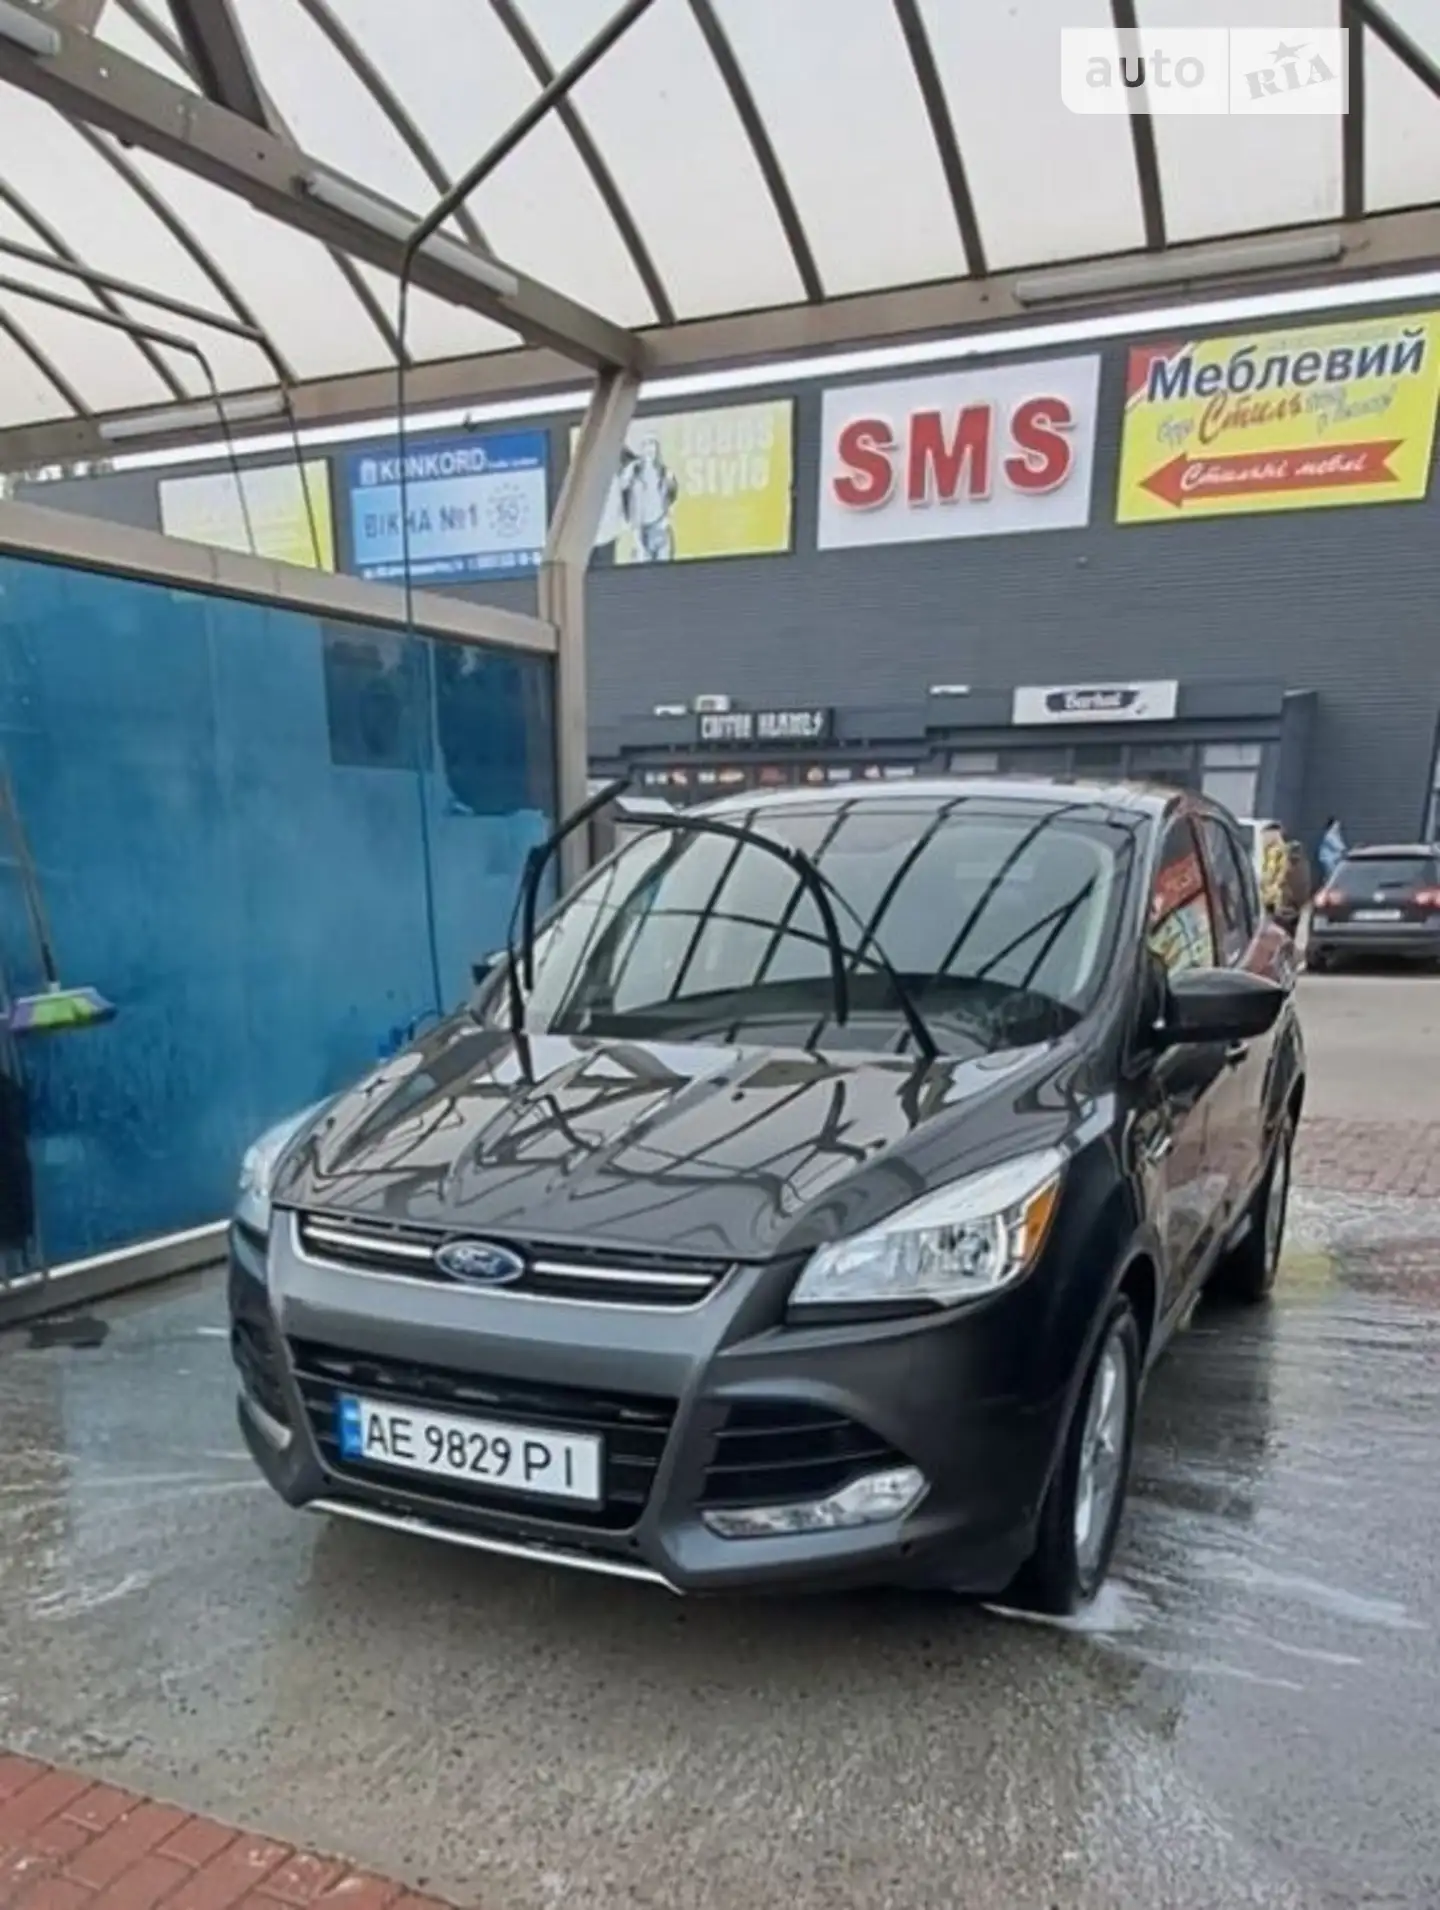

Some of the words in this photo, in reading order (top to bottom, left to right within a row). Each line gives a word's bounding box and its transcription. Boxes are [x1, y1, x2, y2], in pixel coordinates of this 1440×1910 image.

[1148, 327, 1426, 402] Меблевий
[380, 448, 486, 482] KONKORD
[832, 396, 1075, 511] SMS
[366, 1413, 415, 1459] AE
[424, 1425, 511, 1477] 9829
[523, 1441, 573, 1488] PI
